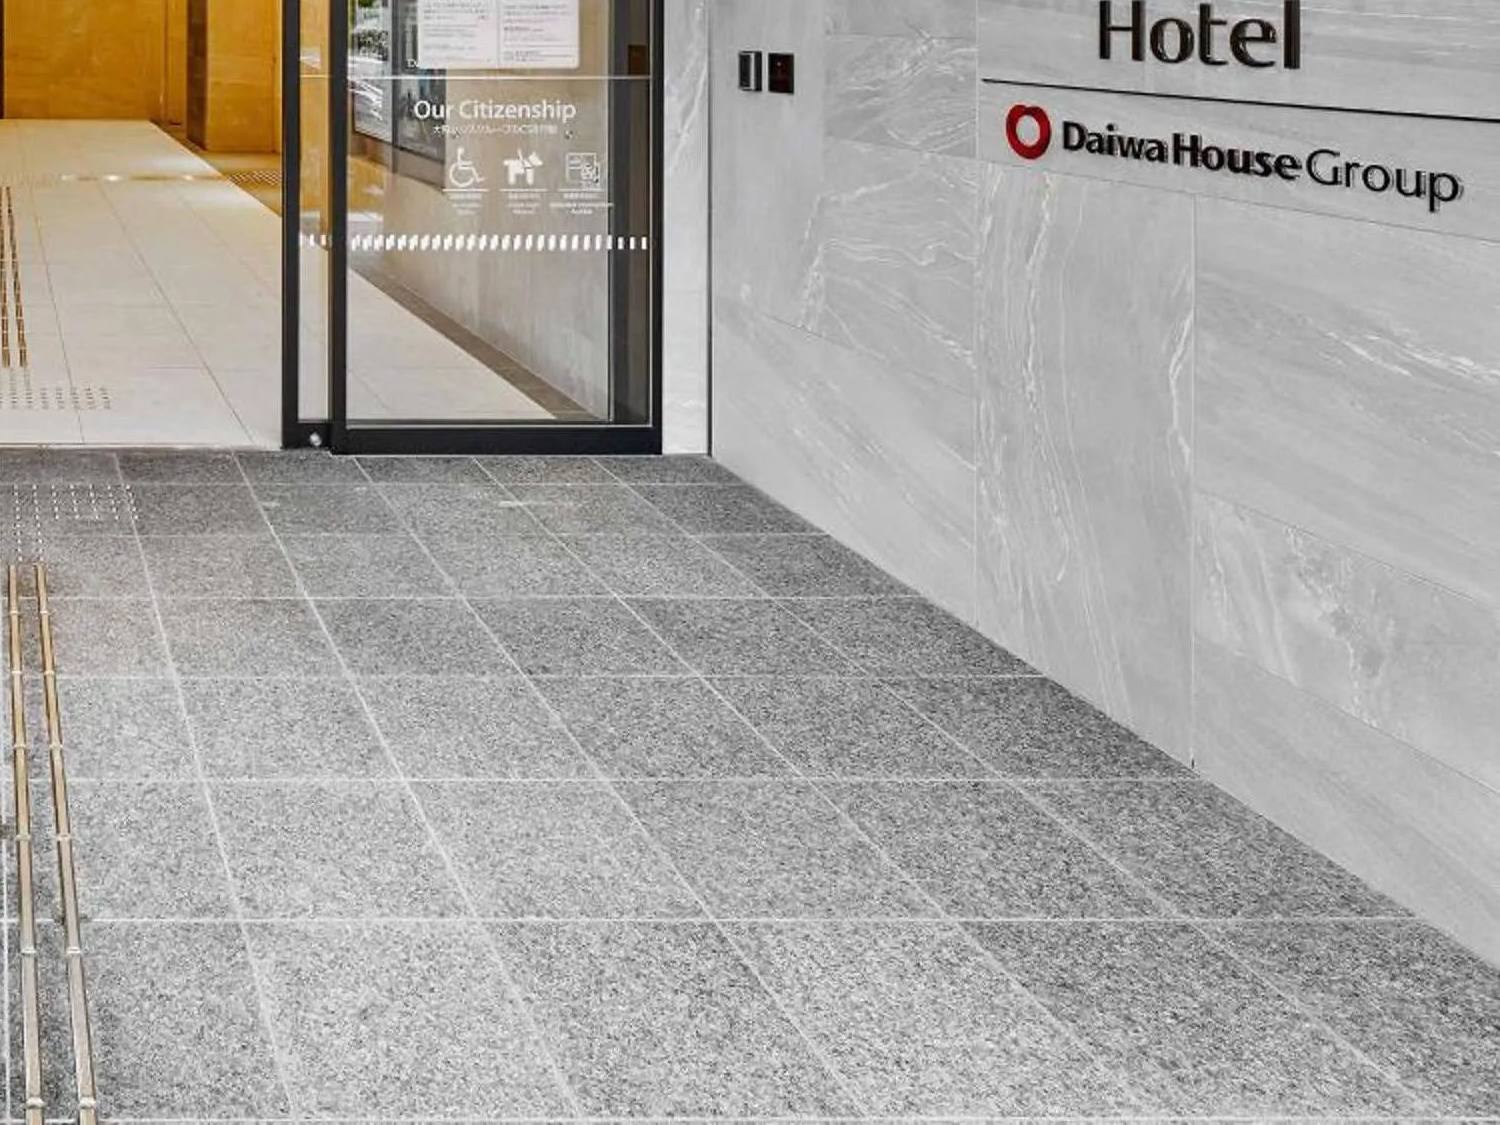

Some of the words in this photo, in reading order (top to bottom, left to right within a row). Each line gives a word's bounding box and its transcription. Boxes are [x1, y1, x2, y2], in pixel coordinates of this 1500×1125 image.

[1099, 0, 1301, 69] Hotel
[414, 101, 451, 119] Our
[459, 100, 577, 124] Citizenship
[1062, 121, 1168, 164] Daiwa
[1172, 132, 1301, 180] House
[1306, 149, 1463, 212] Group
